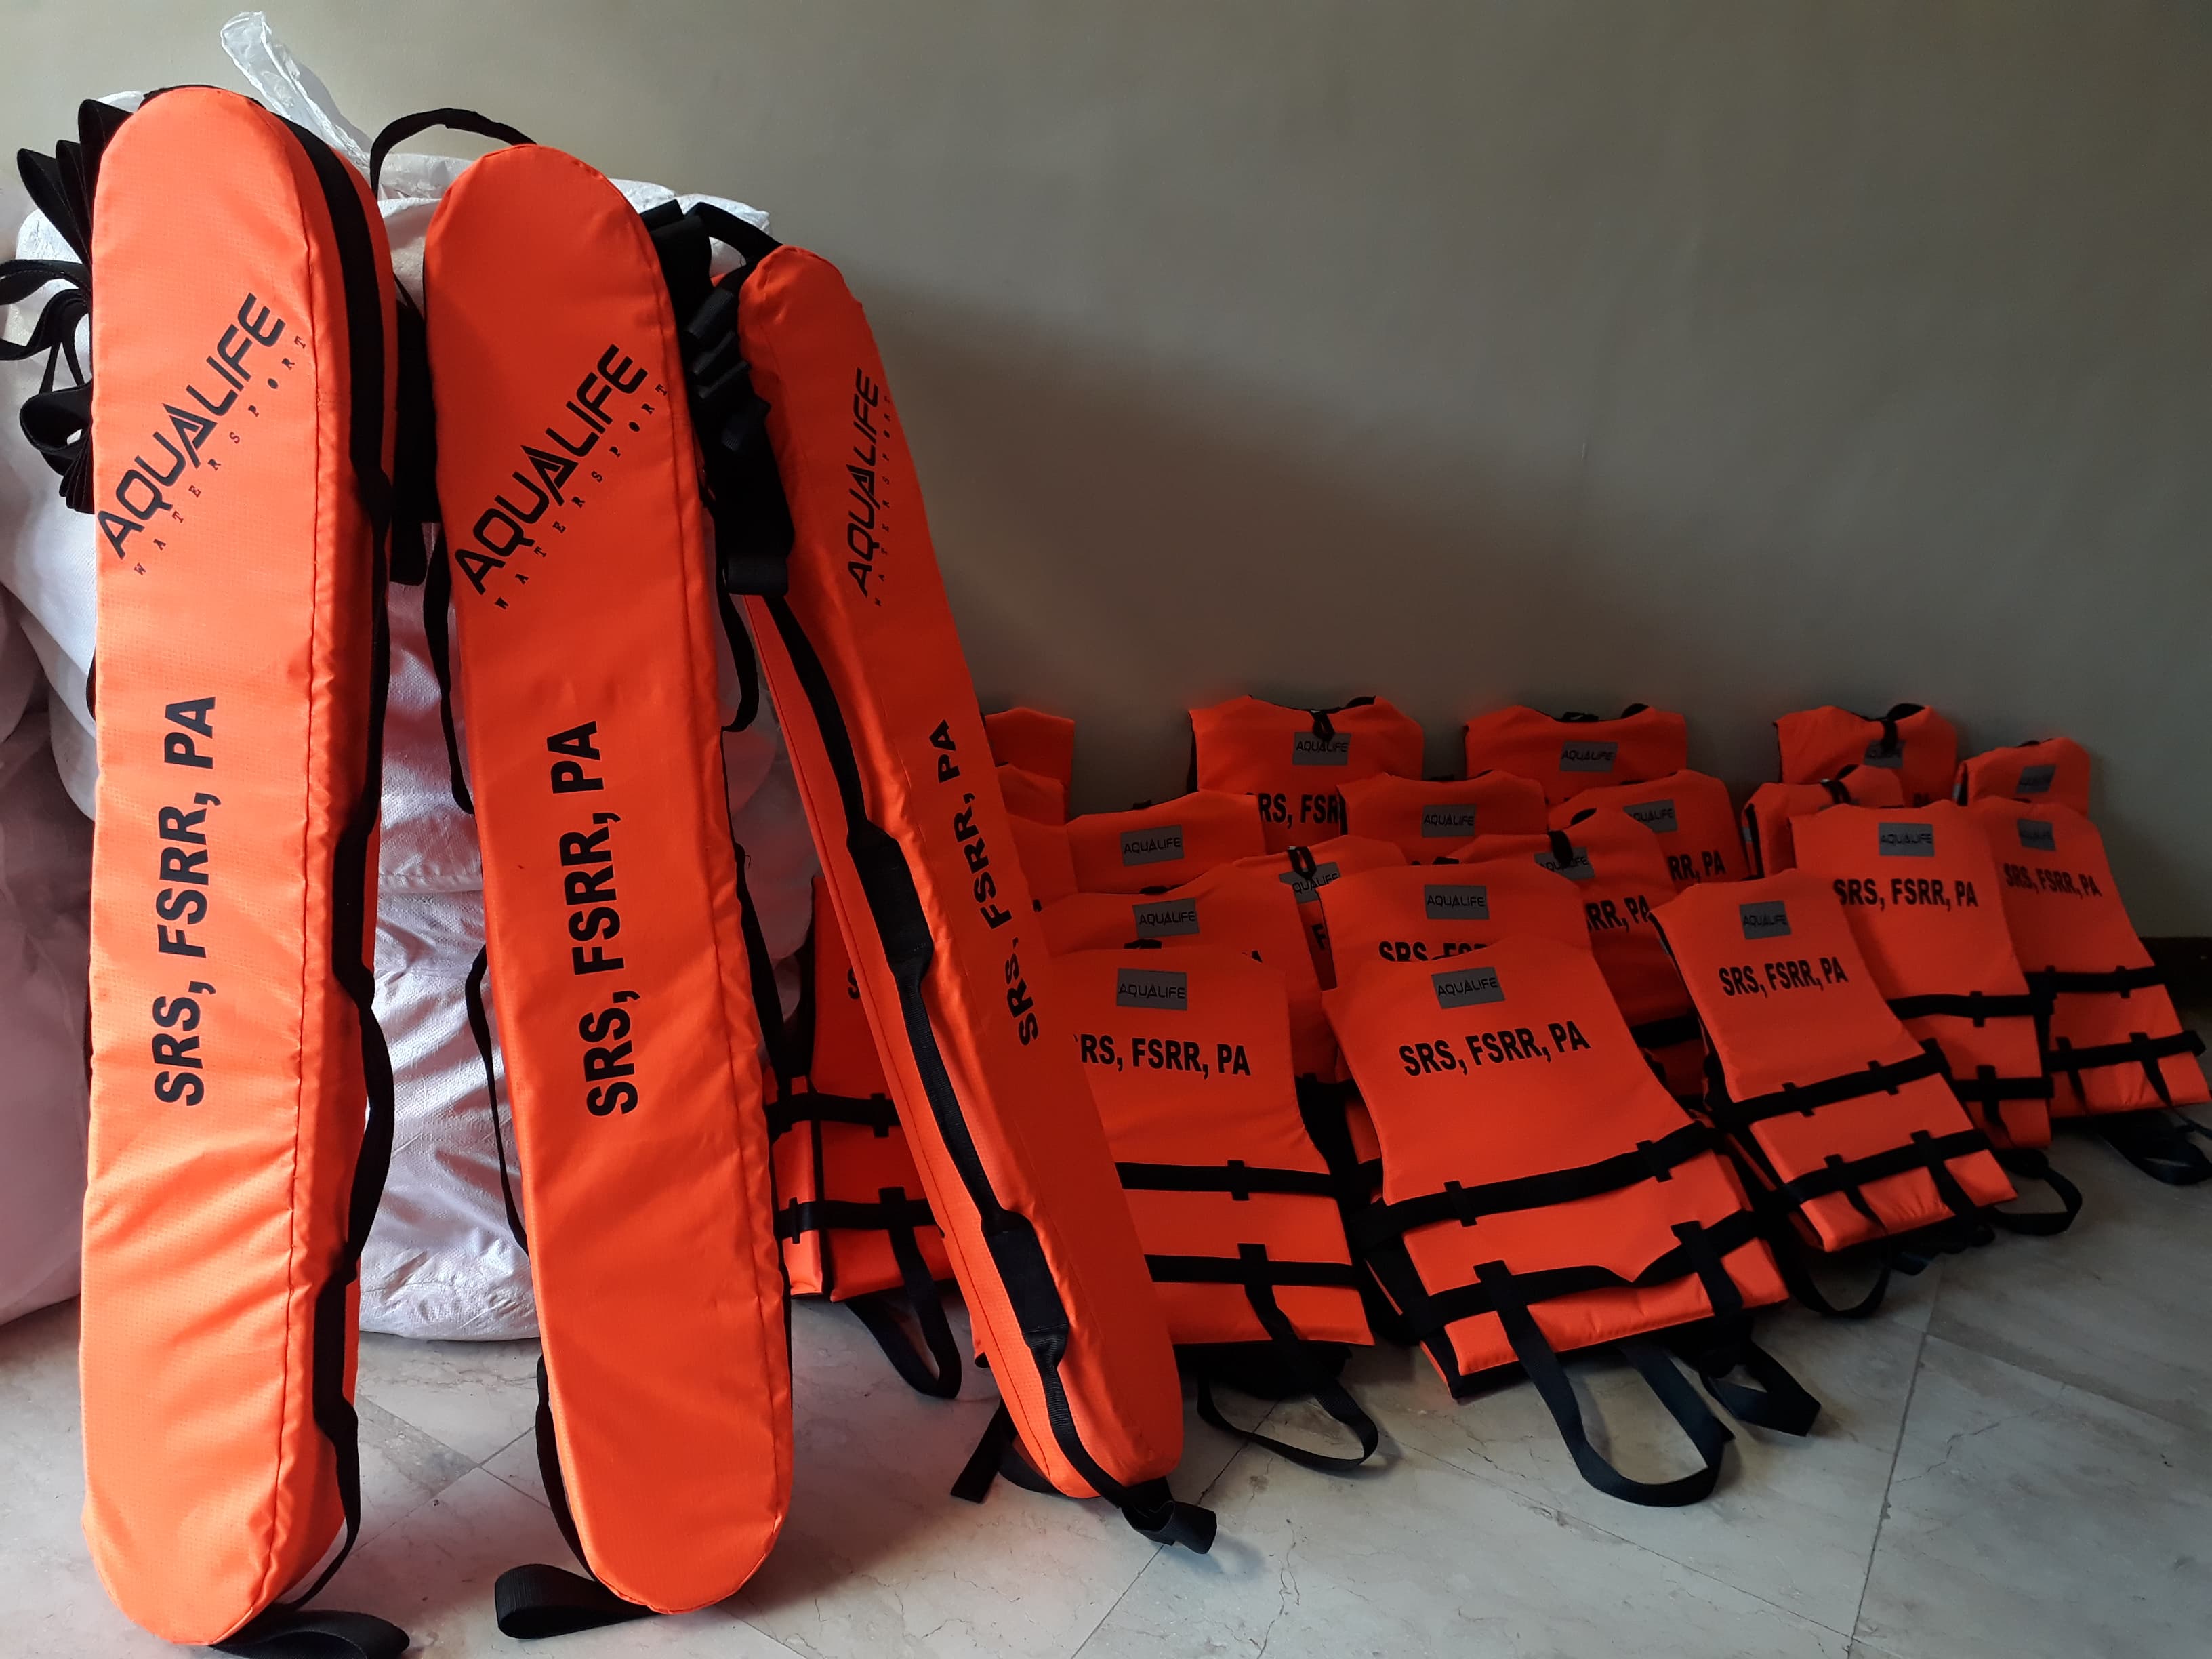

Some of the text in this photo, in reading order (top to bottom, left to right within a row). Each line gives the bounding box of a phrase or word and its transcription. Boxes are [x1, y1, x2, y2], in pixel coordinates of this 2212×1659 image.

[98, 293, 285, 559] AQUALIFE
[134, 335, 305, 575] WATERSPORT
[455, 344, 648, 595] AQUALIFE
[495, 384, 668, 609] WATERSPORT
[846, 367, 880, 597] AQUALIFE
[1296, 741, 1348, 752] AQUALIFE
[1561, 750, 1614, 761] AQUALIFE
[1258, 793, 1338, 830] RS, FSR
[1424, 813, 1474, 827] AQUALIFE
[1629, 808, 1673, 822] QUALIFE
[1124, 837, 1181, 854] AQUALIFE
[929, 720, 1038, 1046] SRS, FSRR, PA
[1668, 851, 1725, 883] RR, PA
[1292, 873, 1338, 894] QUALIFE
[1833, 879, 1978, 912] SRS, FSRR, PA
[2078, 874, 2102, 897] PA
[152, 697, 222, 1106] SRS, FSRR, PA
[1427, 895, 1486, 907] AQUALIFE
[1586, 895, 1650, 933] RR, PA
[547, 721, 640, 1117] SRS, FSRR, PA
[1139, 911, 1195, 926] AQUALIFE
[1743, 915, 1787, 927] AQUALIFE
[1378, 941, 1427, 962] SRS
[1118, 983, 1185, 999] AQUALIFE
[1438, 977, 1498, 996] AQUALIFE
[1719, 956, 1849, 998] SRS, FSRR, PA
[1073, 1033, 1250, 1079] RS, FSRR, PA
[1399, 1021, 1591, 1076] SRS, FSRR, PA
